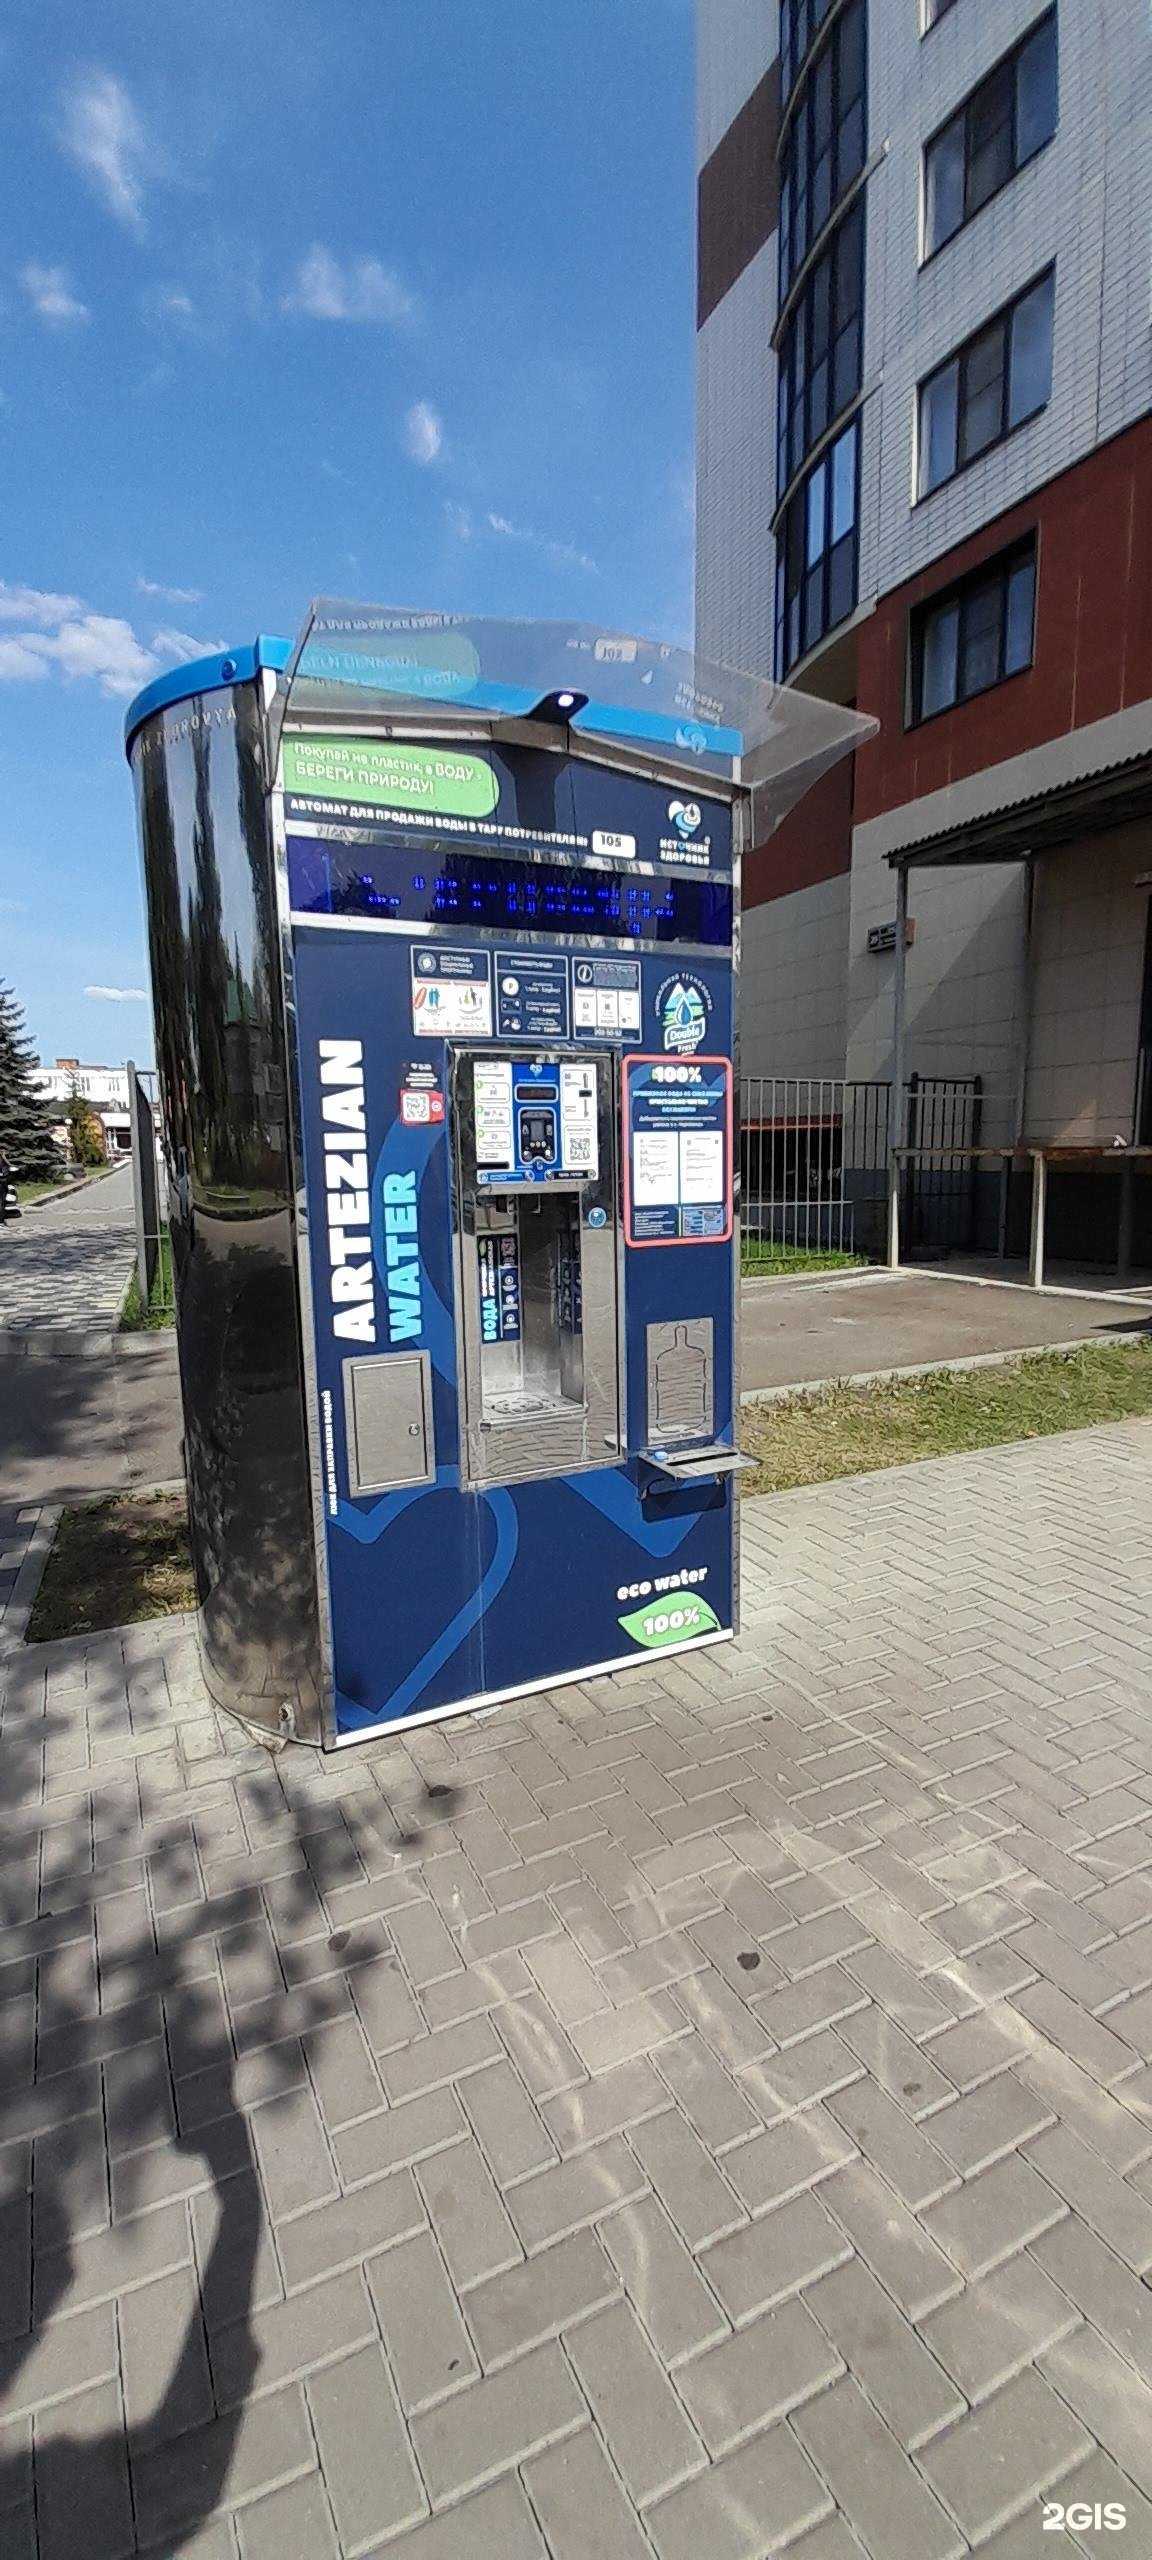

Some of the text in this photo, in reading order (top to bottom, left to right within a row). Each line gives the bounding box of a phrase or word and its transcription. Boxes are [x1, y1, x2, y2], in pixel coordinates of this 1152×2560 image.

[294, 741, 350, 761] Покупай
[351, 754, 369, 765] не
[425, 766, 433, 776] а
[435, 762, 475, 781] ВОДУ
[295, 761, 434, 796] БЕРЕГИ ПРИРОДУ!
[290, 798, 349, 817] АВТОМАТ
[350, 806, 374, 819] ДЛЯ
[375, 809, 434, 826] ПРОДАЖИ
[435, 816, 468, 832] ВОДЫ
[469, 821, 477, 833] В
[477, 822, 503, 836] ТАРУ
[600, 833, 622, 848] 105
[653, 1065, 702, 1083] 100%
[319, 1039, 376, 1343] ARTEZIAN
[383, 1170, 422, 1343] WATER
[482, 1298, 498, 1341] ВОДА
[321, 1390, 333, 1424] ВОДОЙ
[617, 1566, 708, 1600] eco water
[642, 1607, 700, 1636] 100%
